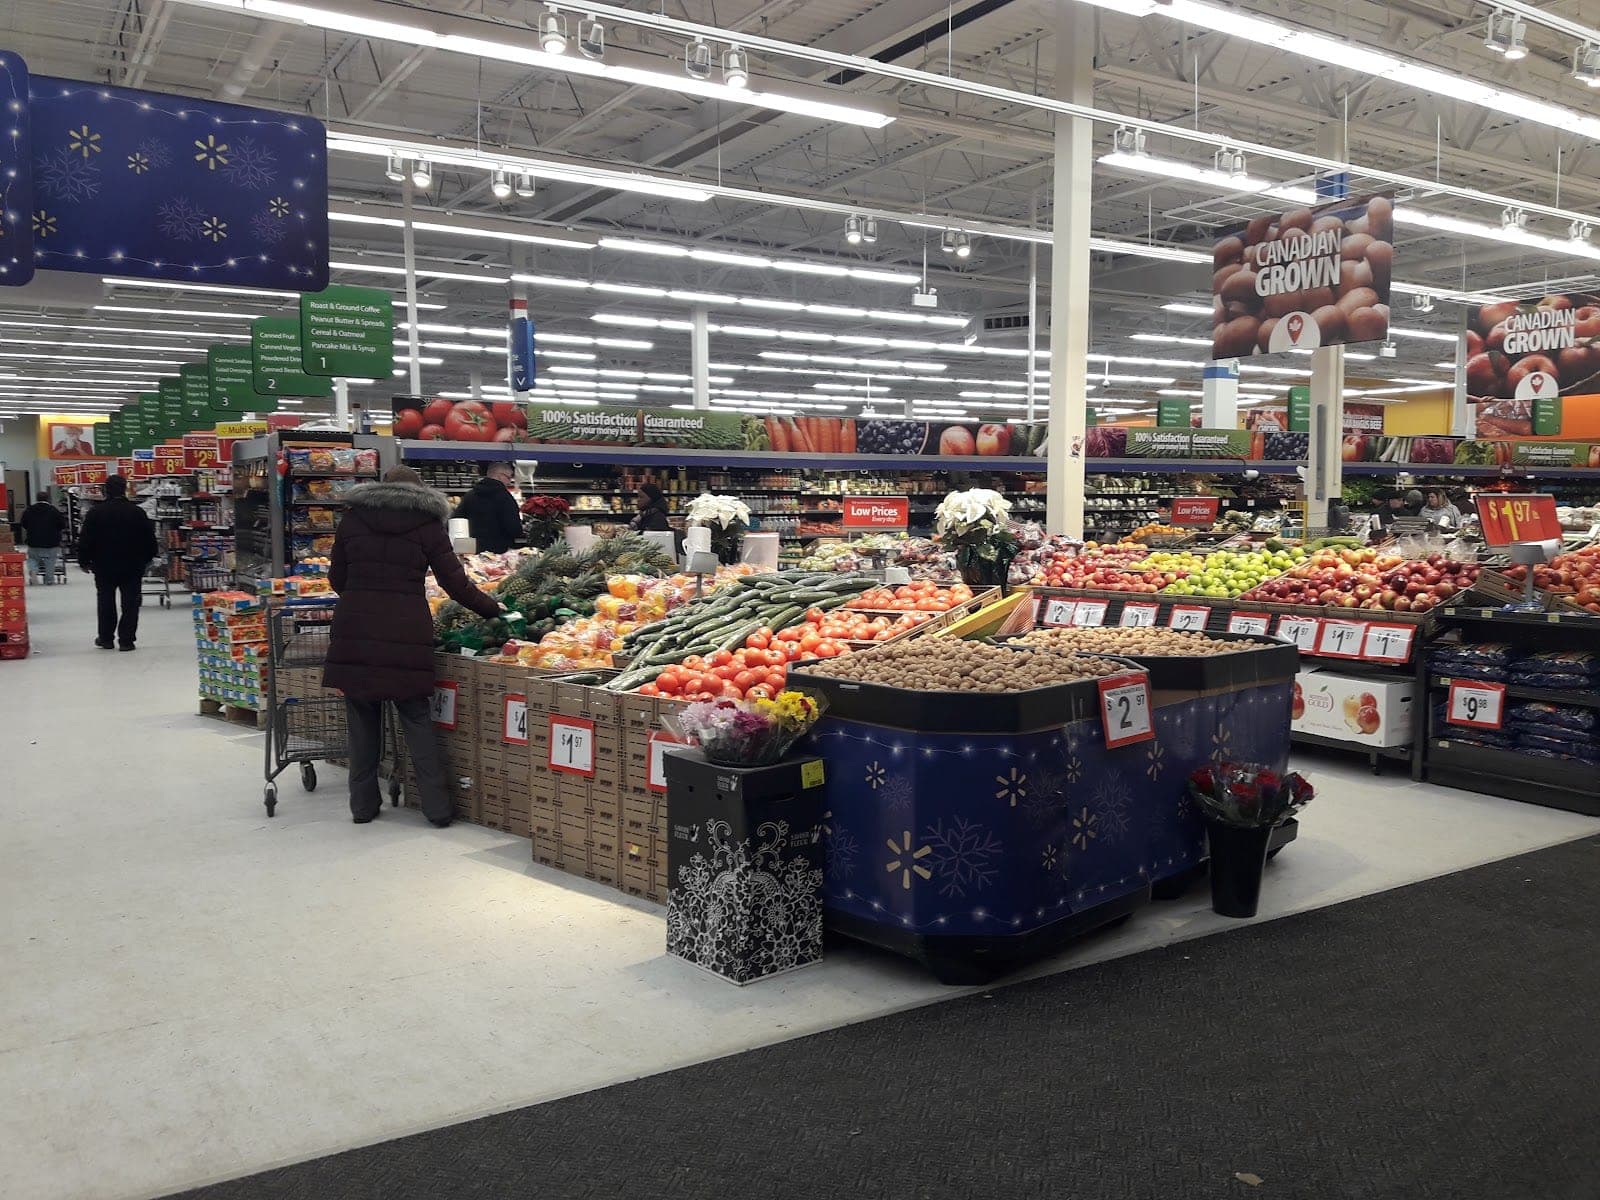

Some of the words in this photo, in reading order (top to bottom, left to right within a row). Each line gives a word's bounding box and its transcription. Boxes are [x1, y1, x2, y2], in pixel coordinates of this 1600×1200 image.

[1256, 228, 1341, 266] CANADIAN
[1255, 254, 1340, 296] GROWN
[361, 319, 385, 327] Spreads
[1504, 308, 1576, 332] CANADIAN
[311, 328, 331, 336] Cereal
[339, 330, 365, 338] Oatmeal
[1503, 326, 1575, 354] GROWN
[312, 342, 338, 350] Pancake
[320, 357, 326, 368] 1
[268, 379, 276, 389] 2
[222, 397, 229, 406] 3
[192, 409, 199, 417] 4
[169, 419, 176, 427] 5
[541, 410, 572, 424] 100%
[573, 411, 637, 427] Satisfaction
[644, 414, 703, 429] Guaranteed
[148, 427, 155, 435] 6
[228, 425, 247, 434] Multi
[597, 428, 619, 437] money
[1135, 432, 1152, 442] 100%
[1152, 432, 1190, 442] Satisfaction
[1193, 434, 1229, 444] Guaranteed
[851, 505, 870, 516] Low
[872, 506, 898, 516] Prices
[1177, 506, 1191, 514] Low
[1192, 506, 1210, 514] Prices
